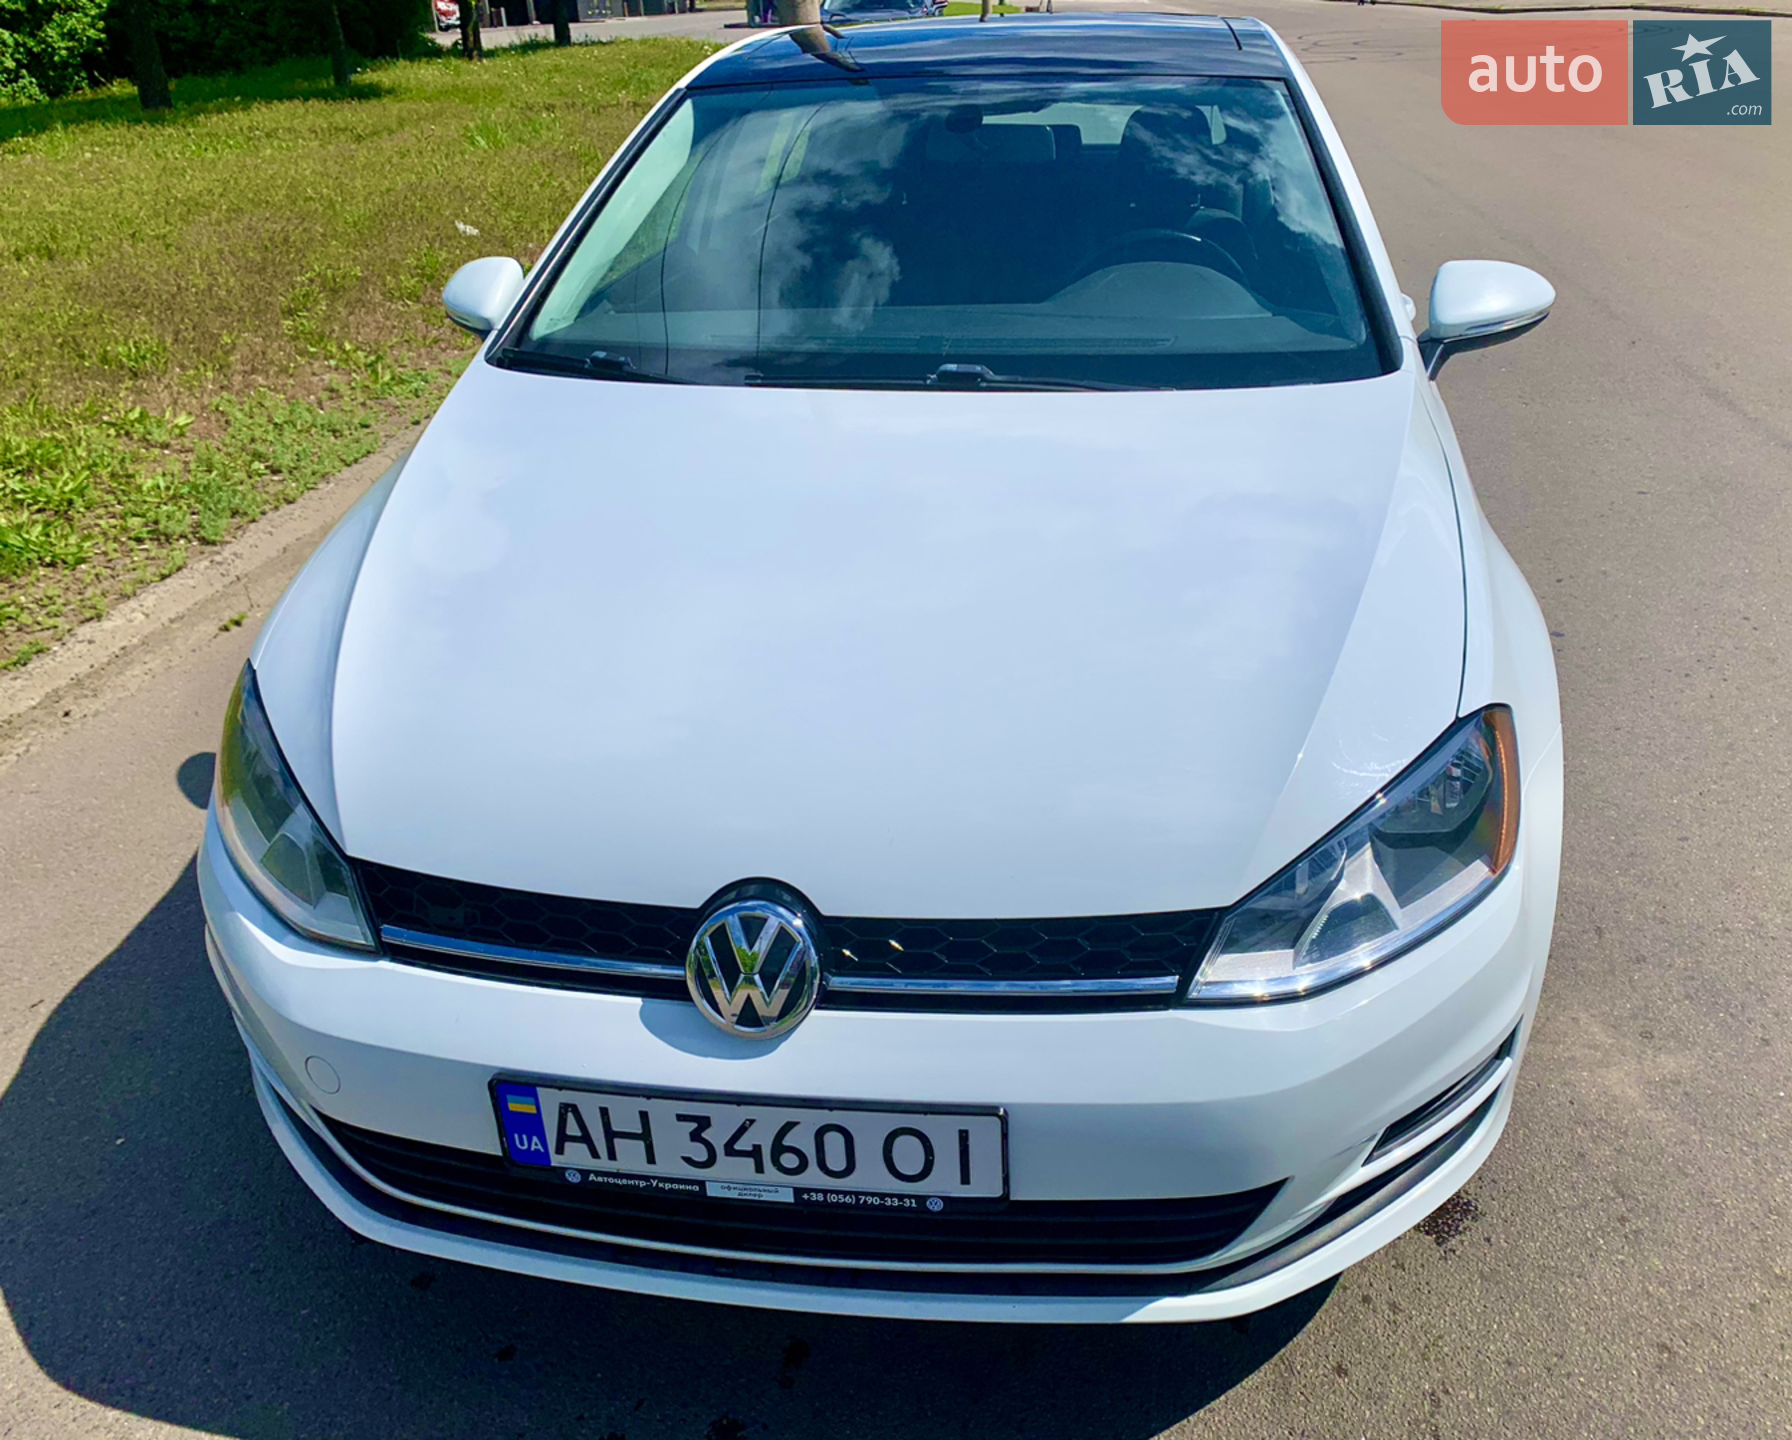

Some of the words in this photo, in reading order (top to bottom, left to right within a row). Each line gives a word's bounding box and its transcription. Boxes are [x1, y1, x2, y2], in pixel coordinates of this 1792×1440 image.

[688, 901, 820, 1038] VW
[514, 1132, 545, 1153] UA
[554, 1102, 657, 1165] AH
[675, 1112, 857, 1180] 3460
[801, 1192, 824, 1202] +38
[827, 1193, 856, 1205] (056)
[858, 1195, 918, 1207] 790-33-31
